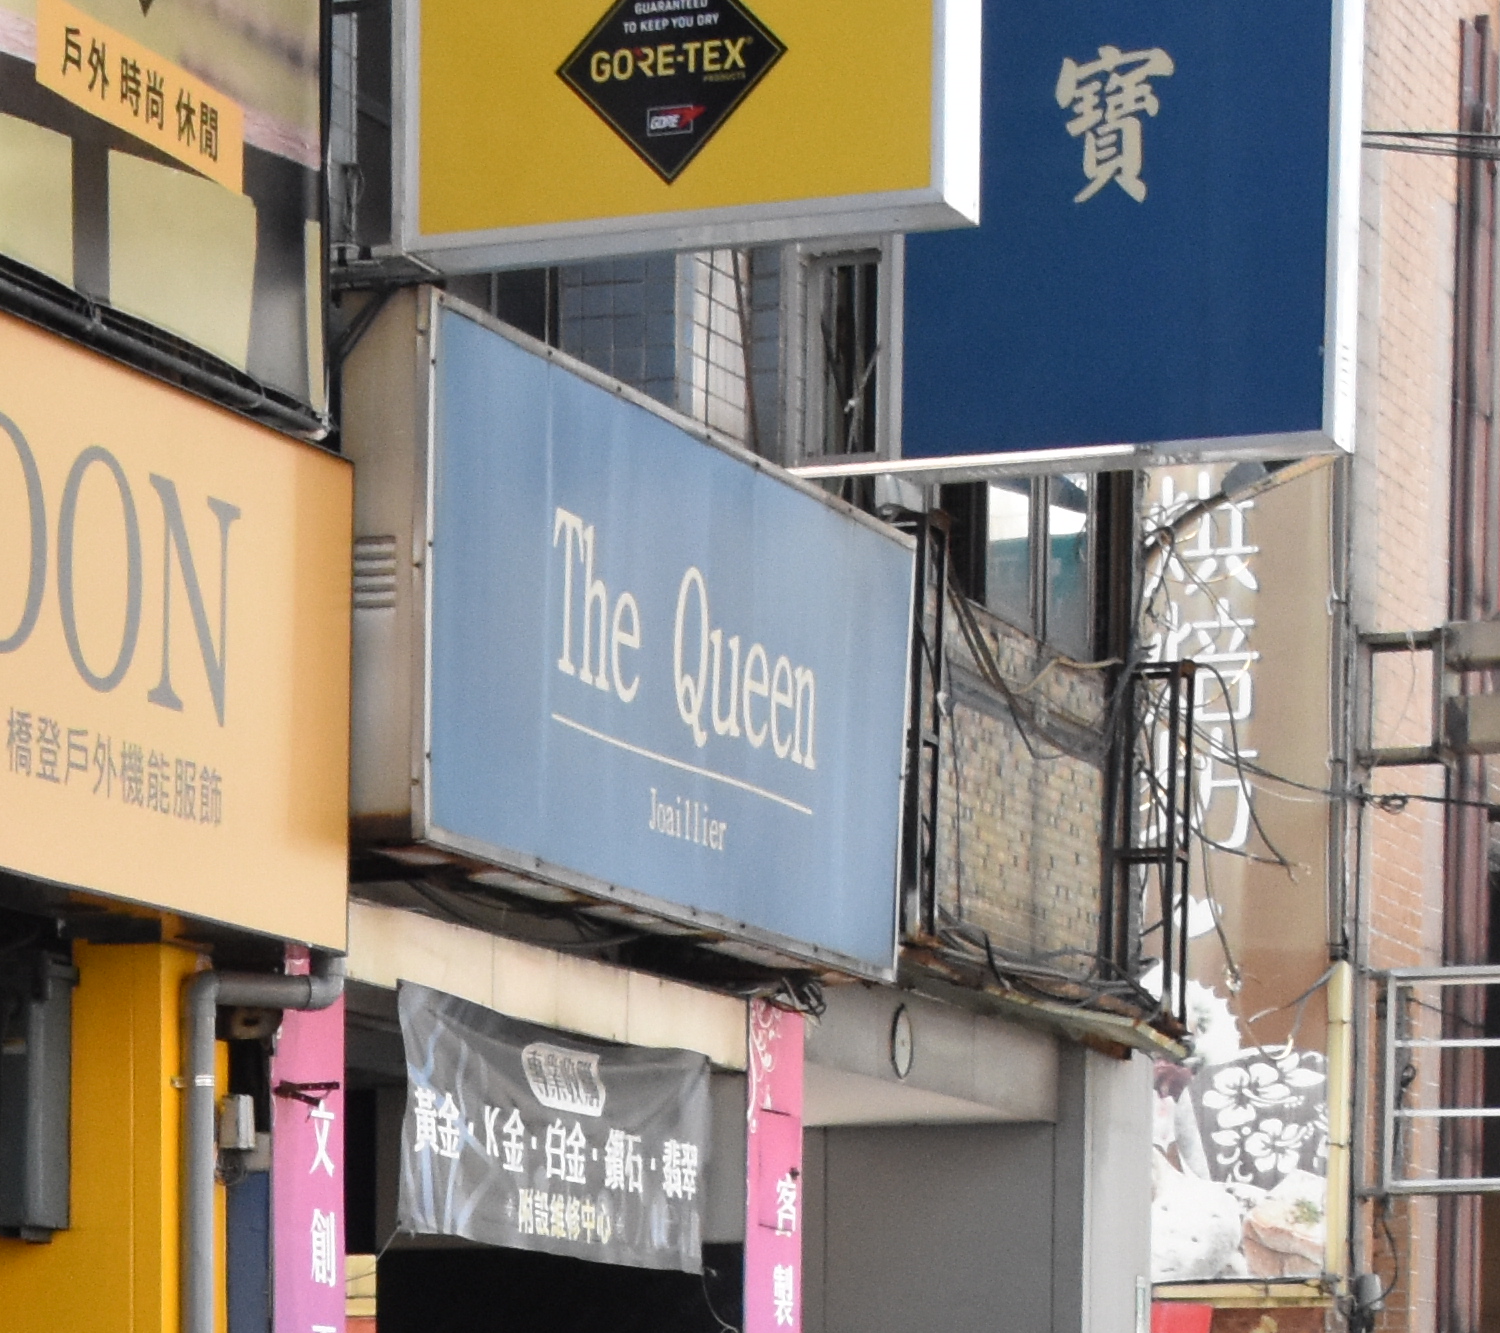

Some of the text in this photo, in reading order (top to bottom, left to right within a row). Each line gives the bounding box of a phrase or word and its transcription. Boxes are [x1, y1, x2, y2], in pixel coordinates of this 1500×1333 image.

[590, 38, 746, 84] GORE-TEX
[623, 13, 719, 34] TO KEEP YOU DRY
[61, 26, 219, 164] 戶外 時尚 休閒
[1054, 44, 1175, 204] 寶
[553, 506, 819, 772] The Queen
[7, 706, 223, 827] 橋登戶外機能服飾
[648, 785, 729, 854] Joaillier
